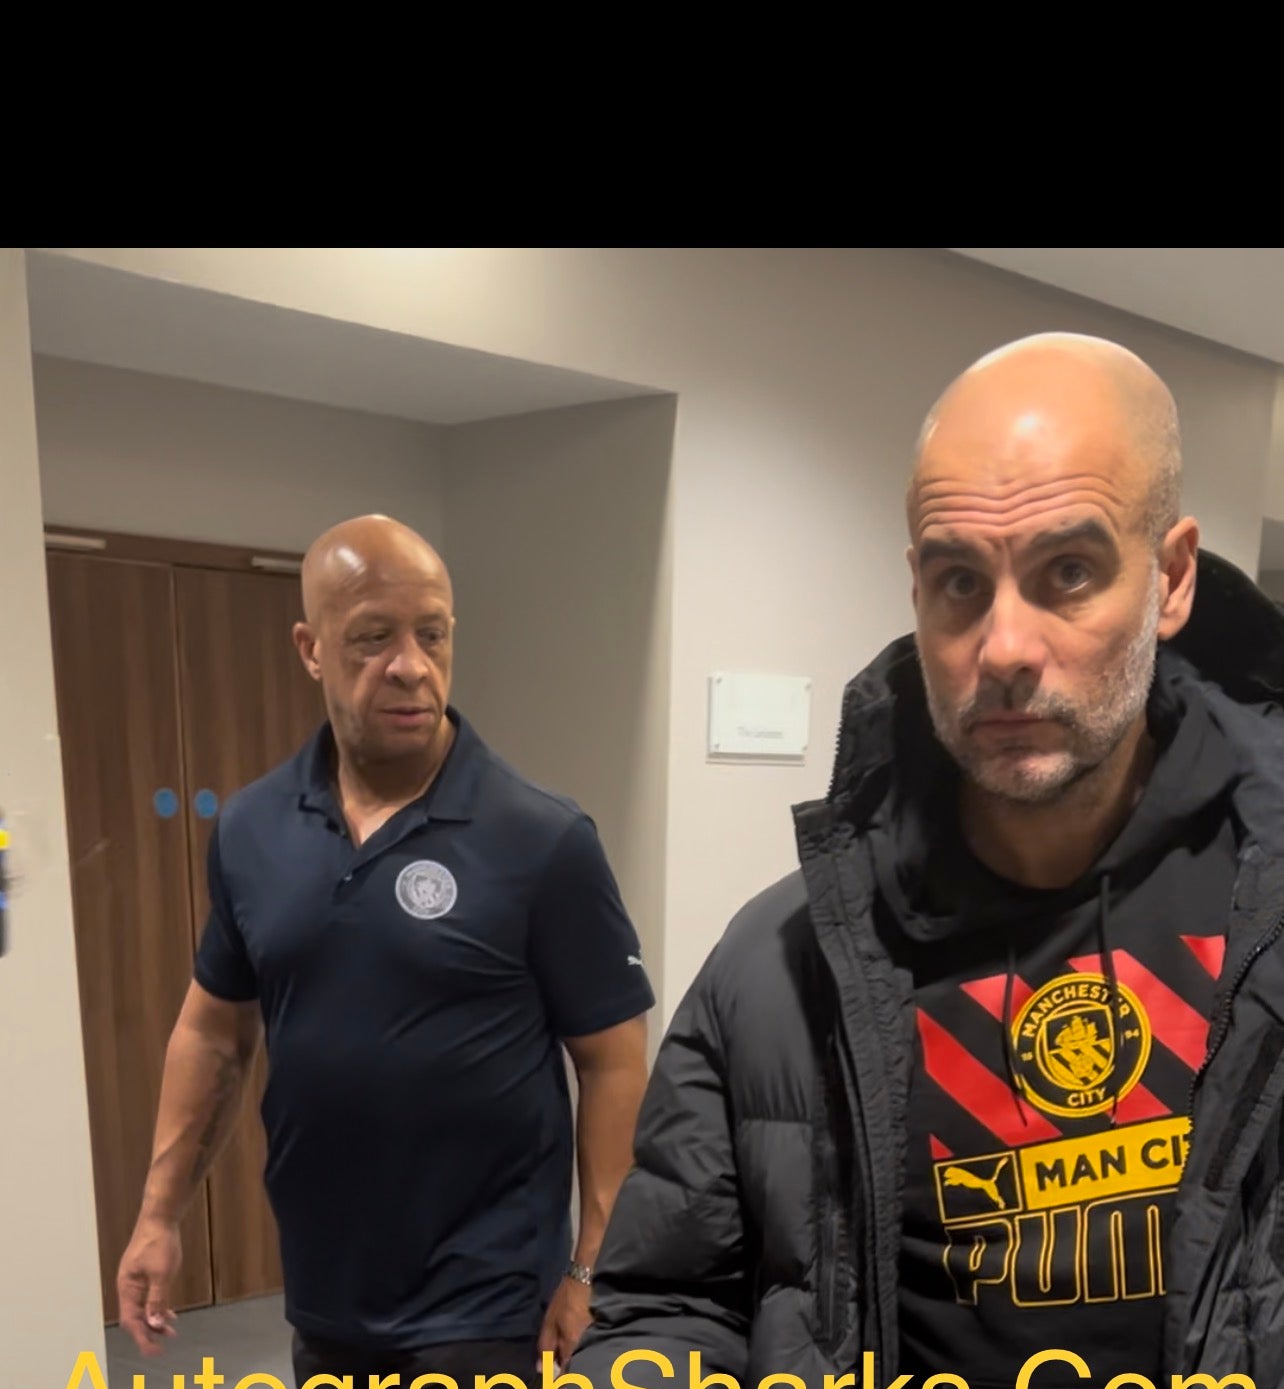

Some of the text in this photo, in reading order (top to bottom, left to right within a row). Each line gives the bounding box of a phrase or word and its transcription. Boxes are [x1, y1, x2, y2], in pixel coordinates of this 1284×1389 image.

[1022, 984, 1131, 1038] MANCHESTR
[1067, 1087, 1107, 1107] CITY
[1035, 1135, 1190, 1192] MAN CI
